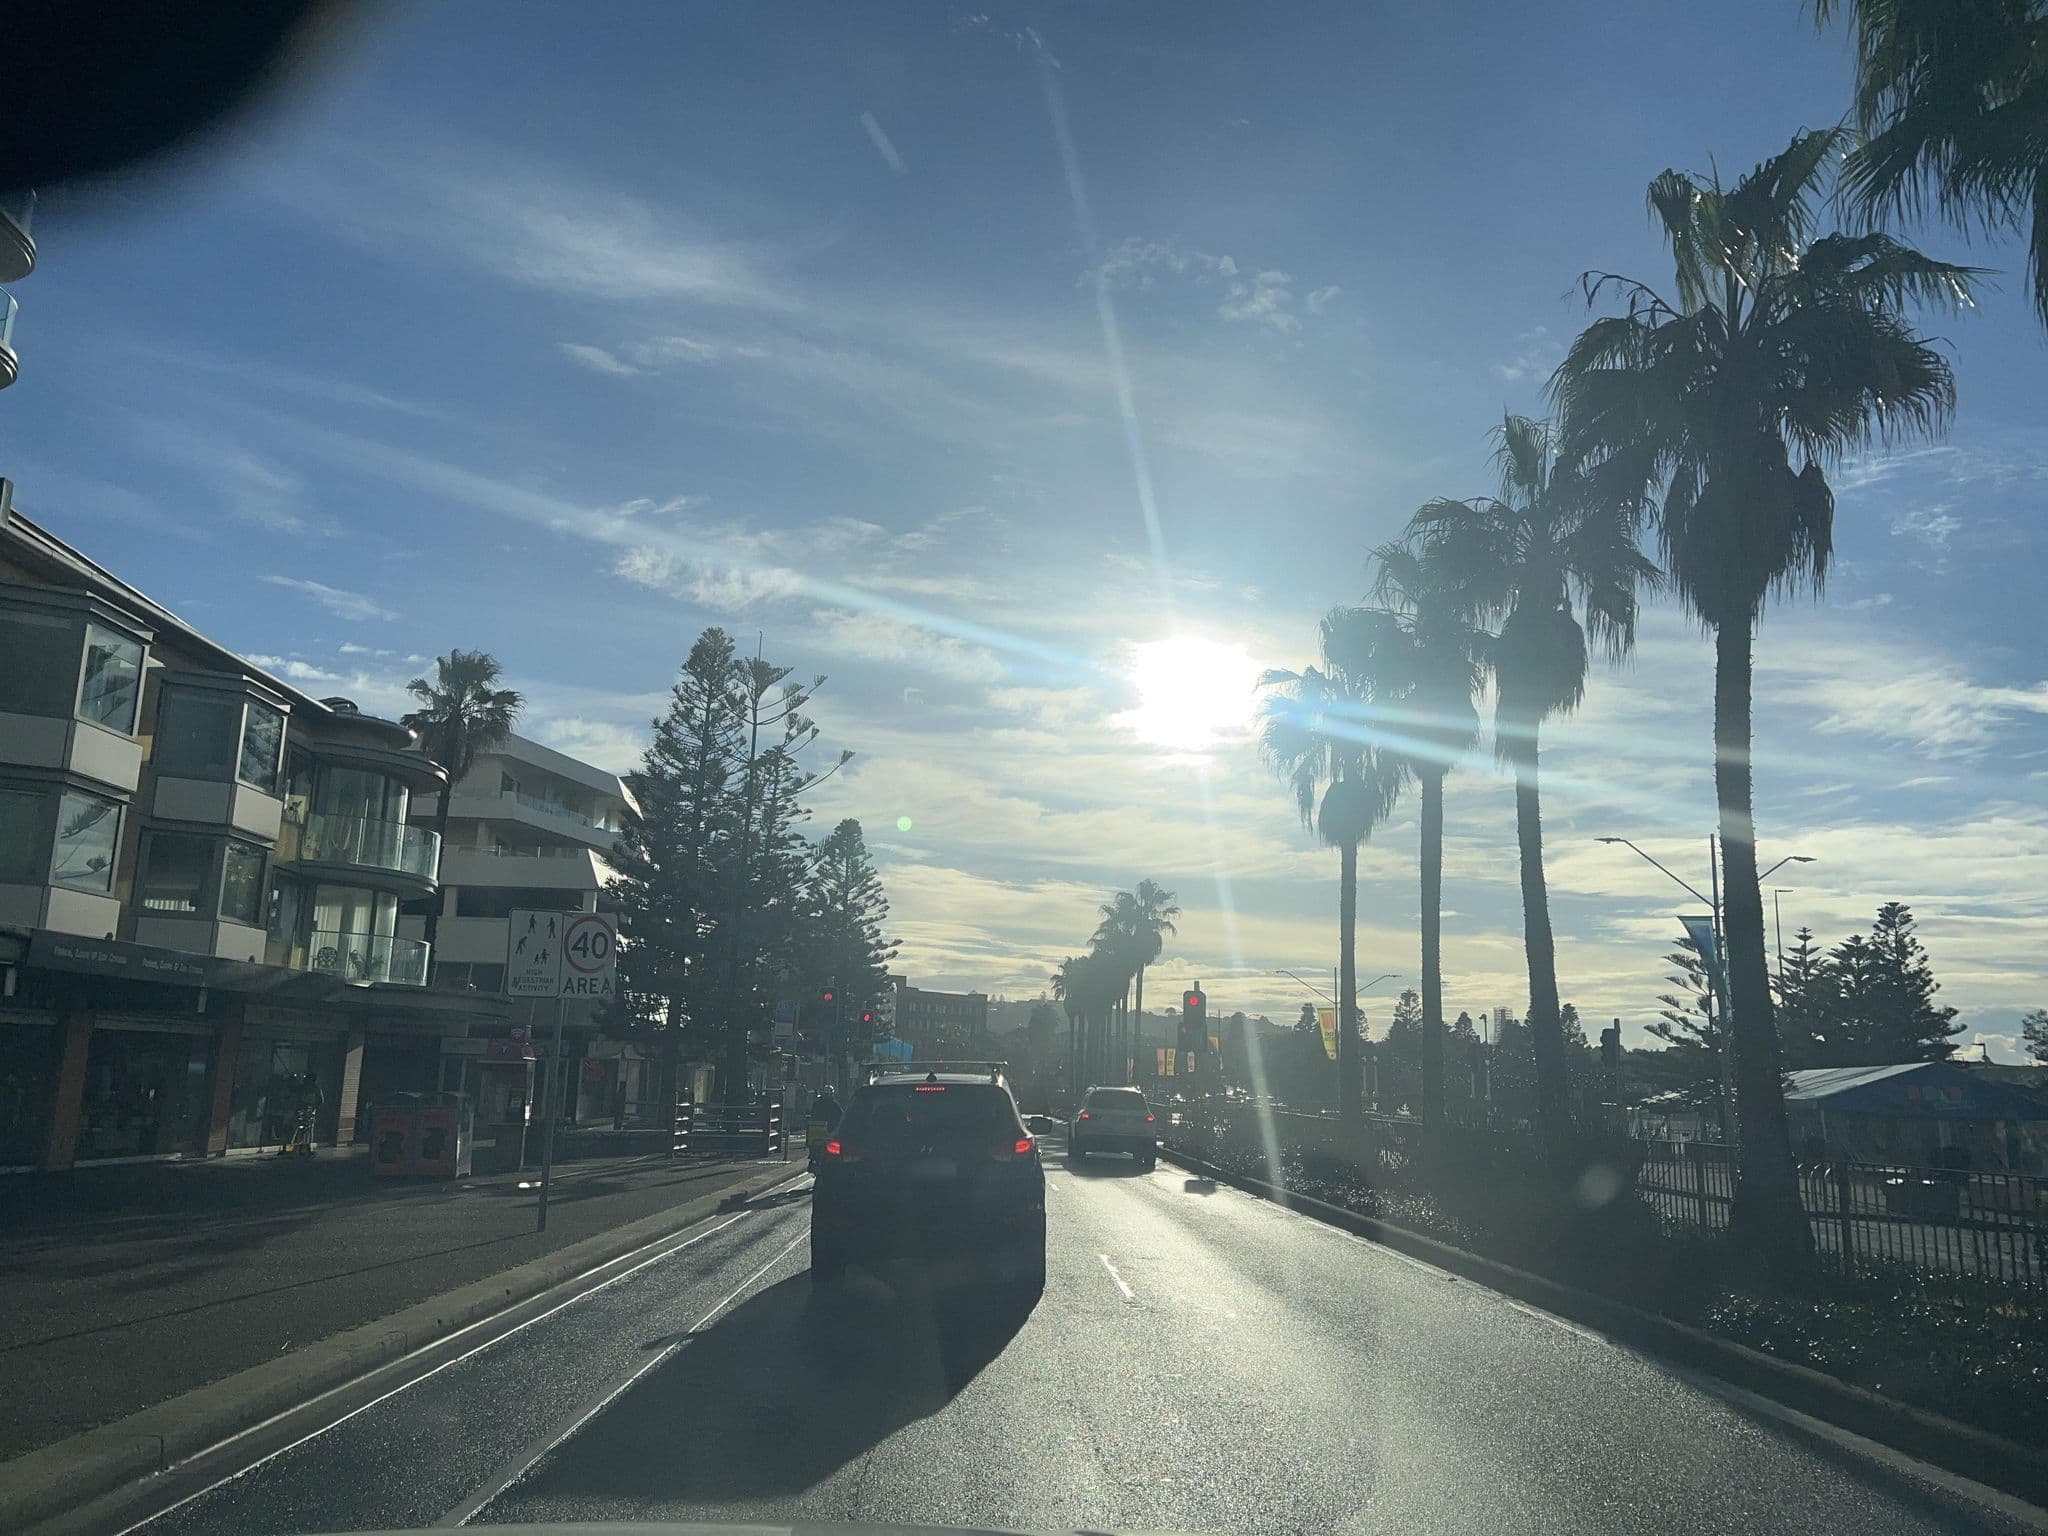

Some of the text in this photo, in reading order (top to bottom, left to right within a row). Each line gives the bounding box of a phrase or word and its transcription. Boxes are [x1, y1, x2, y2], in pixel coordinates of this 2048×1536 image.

[571, 931, 608, 959] 40
[526, 968, 543, 976] HIGH
[512, 977, 554, 985] ESTRIAN
[563, 977, 613, 994] AREA
